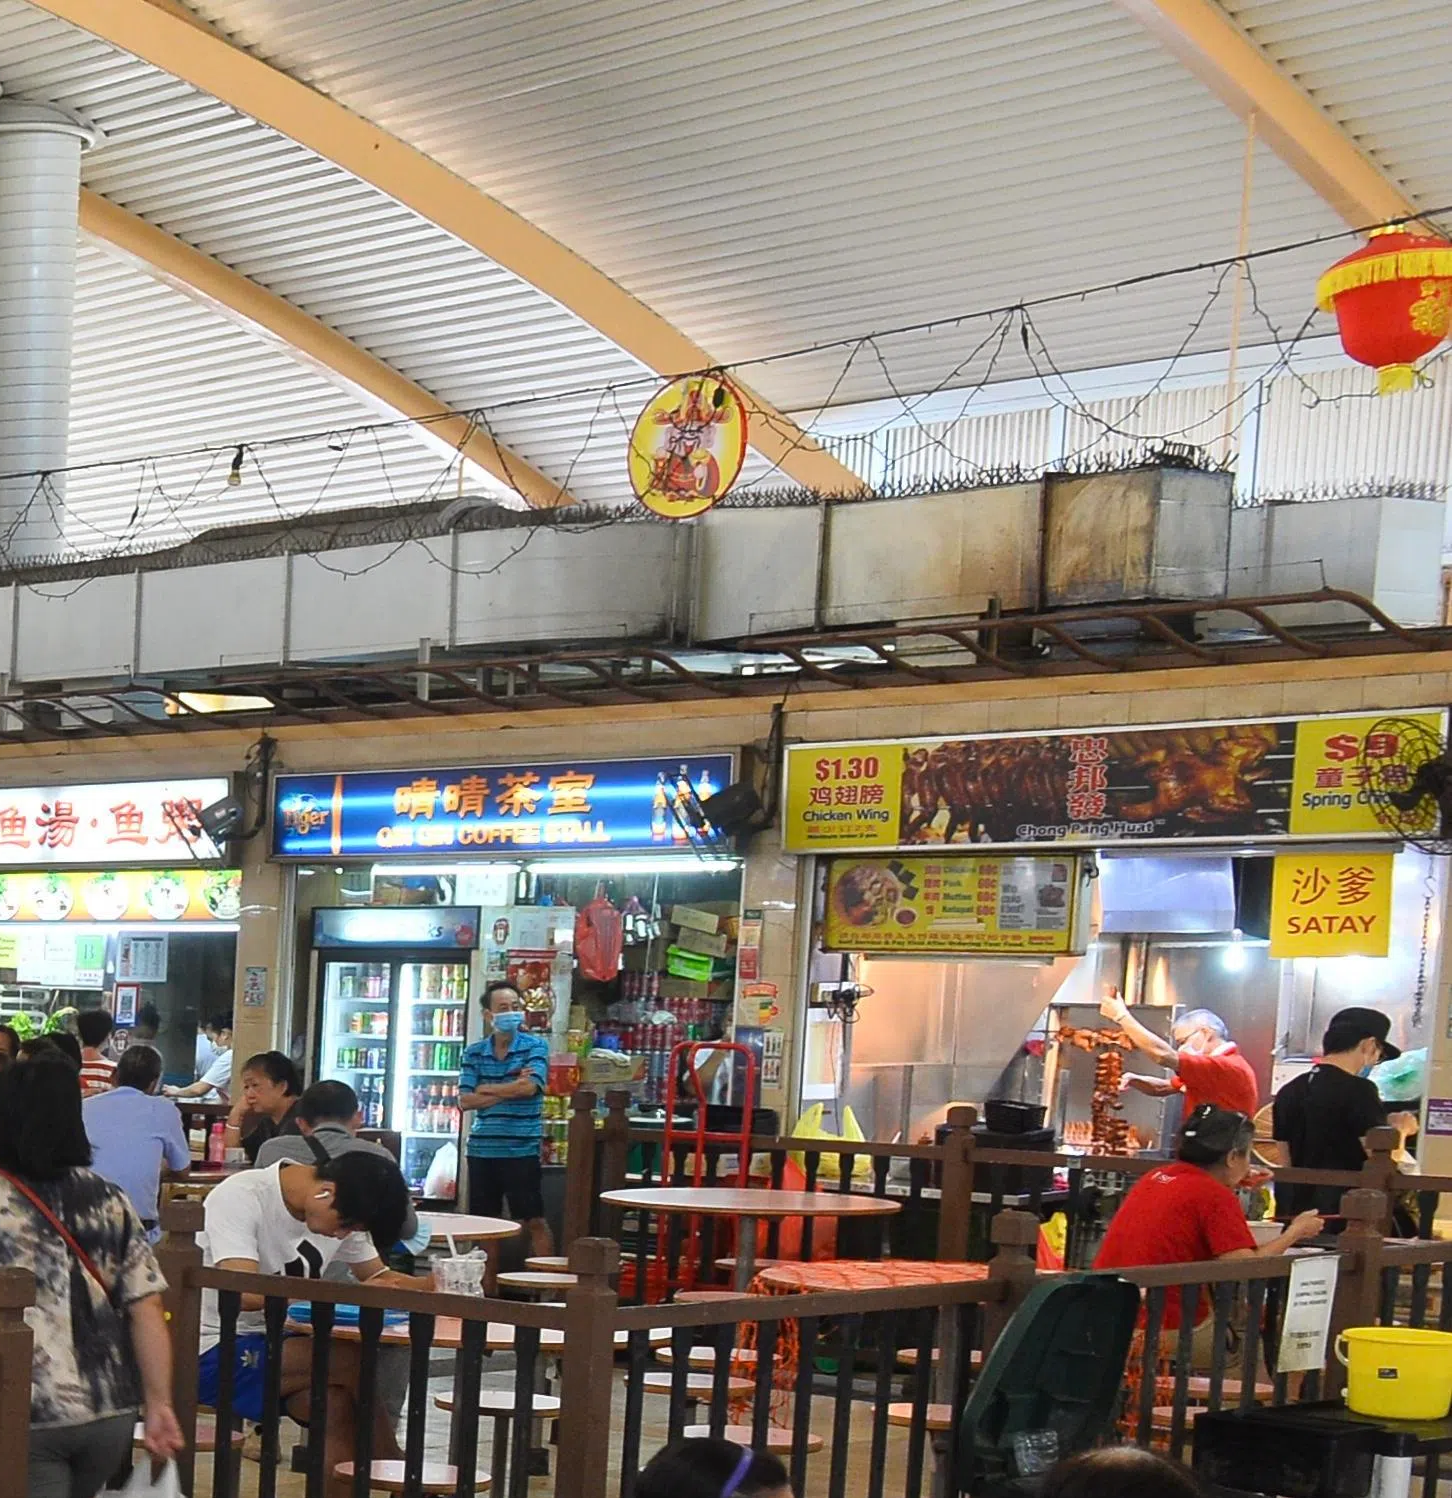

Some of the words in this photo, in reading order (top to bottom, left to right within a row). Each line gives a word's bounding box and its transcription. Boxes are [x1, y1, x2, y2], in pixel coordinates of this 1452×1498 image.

[816, 756, 879, 782] $1.30
[808, 784, 884, 806] 鸡翅膀
[1302, 791, 1352, 810] Spring
[282, 803, 329, 834] Tiger
[802, 809, 852, 822] Chicken
[856, 808, 889, 822] Wing
[458, 822, 541, 846] COFFEE
[544, 820, 611, 844] STALL
[1017, 823, 1067, 837] Chong
[1070, 823, 1113, 837] Pang
[1114, 819, 1154, 834] Huat
[1292, 866, 1376, 905] 沙爹
[1287, 915, 1376, 934] SATAY
